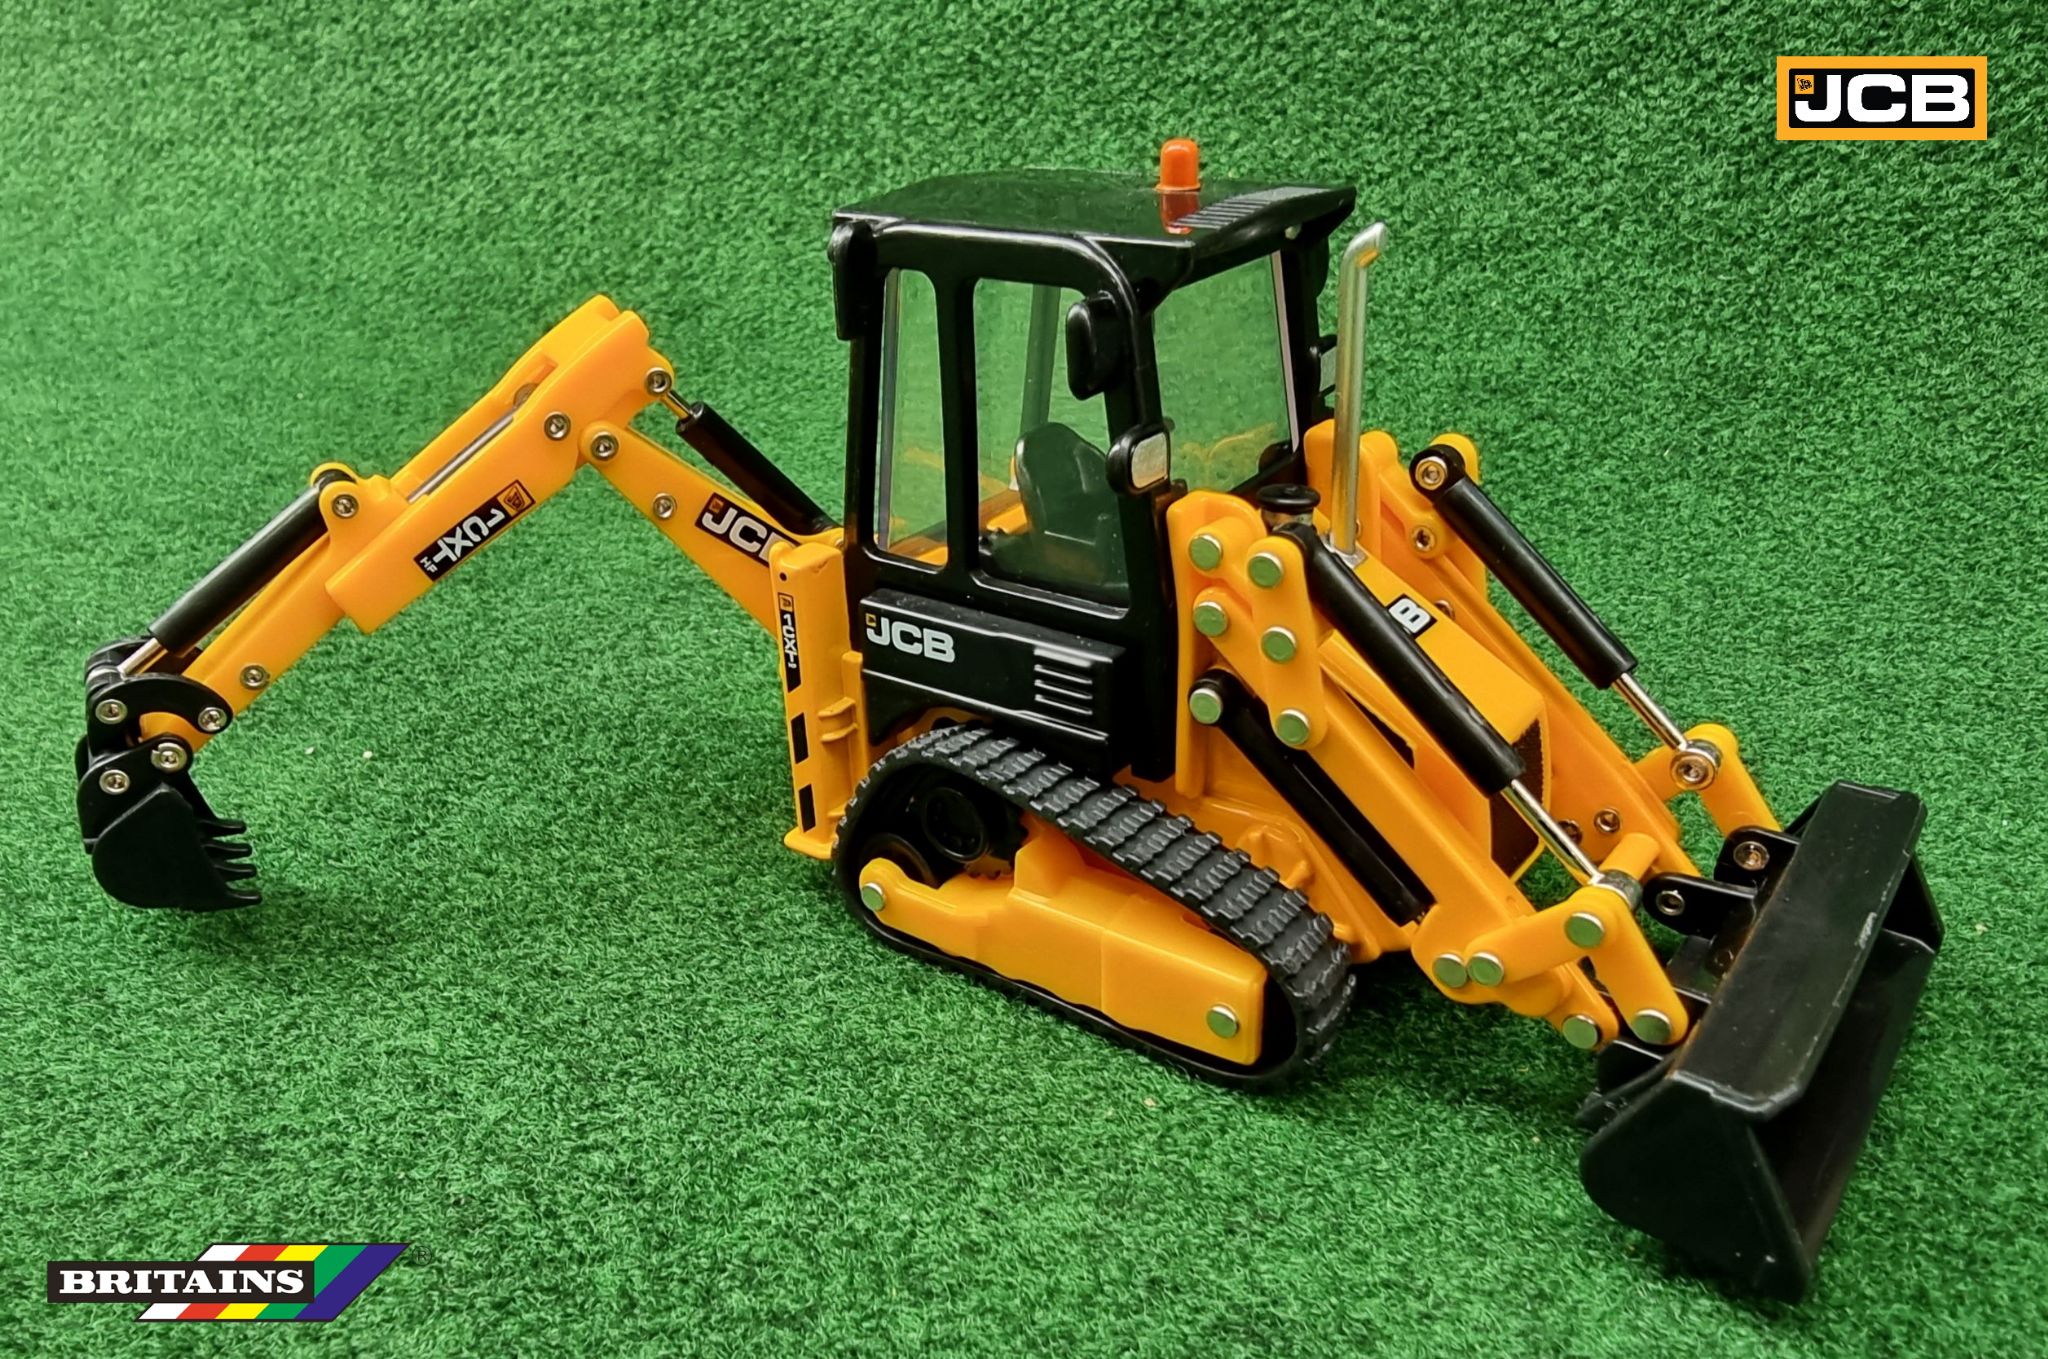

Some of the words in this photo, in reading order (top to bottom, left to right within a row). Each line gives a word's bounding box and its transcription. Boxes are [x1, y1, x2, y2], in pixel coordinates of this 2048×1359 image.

[432, 508, 505, 563] 1CXT
[782, 613, 798, 663] 1CXT
[866, 616, 955, 663] JCB
[1388, 598, 1431, 634] B
